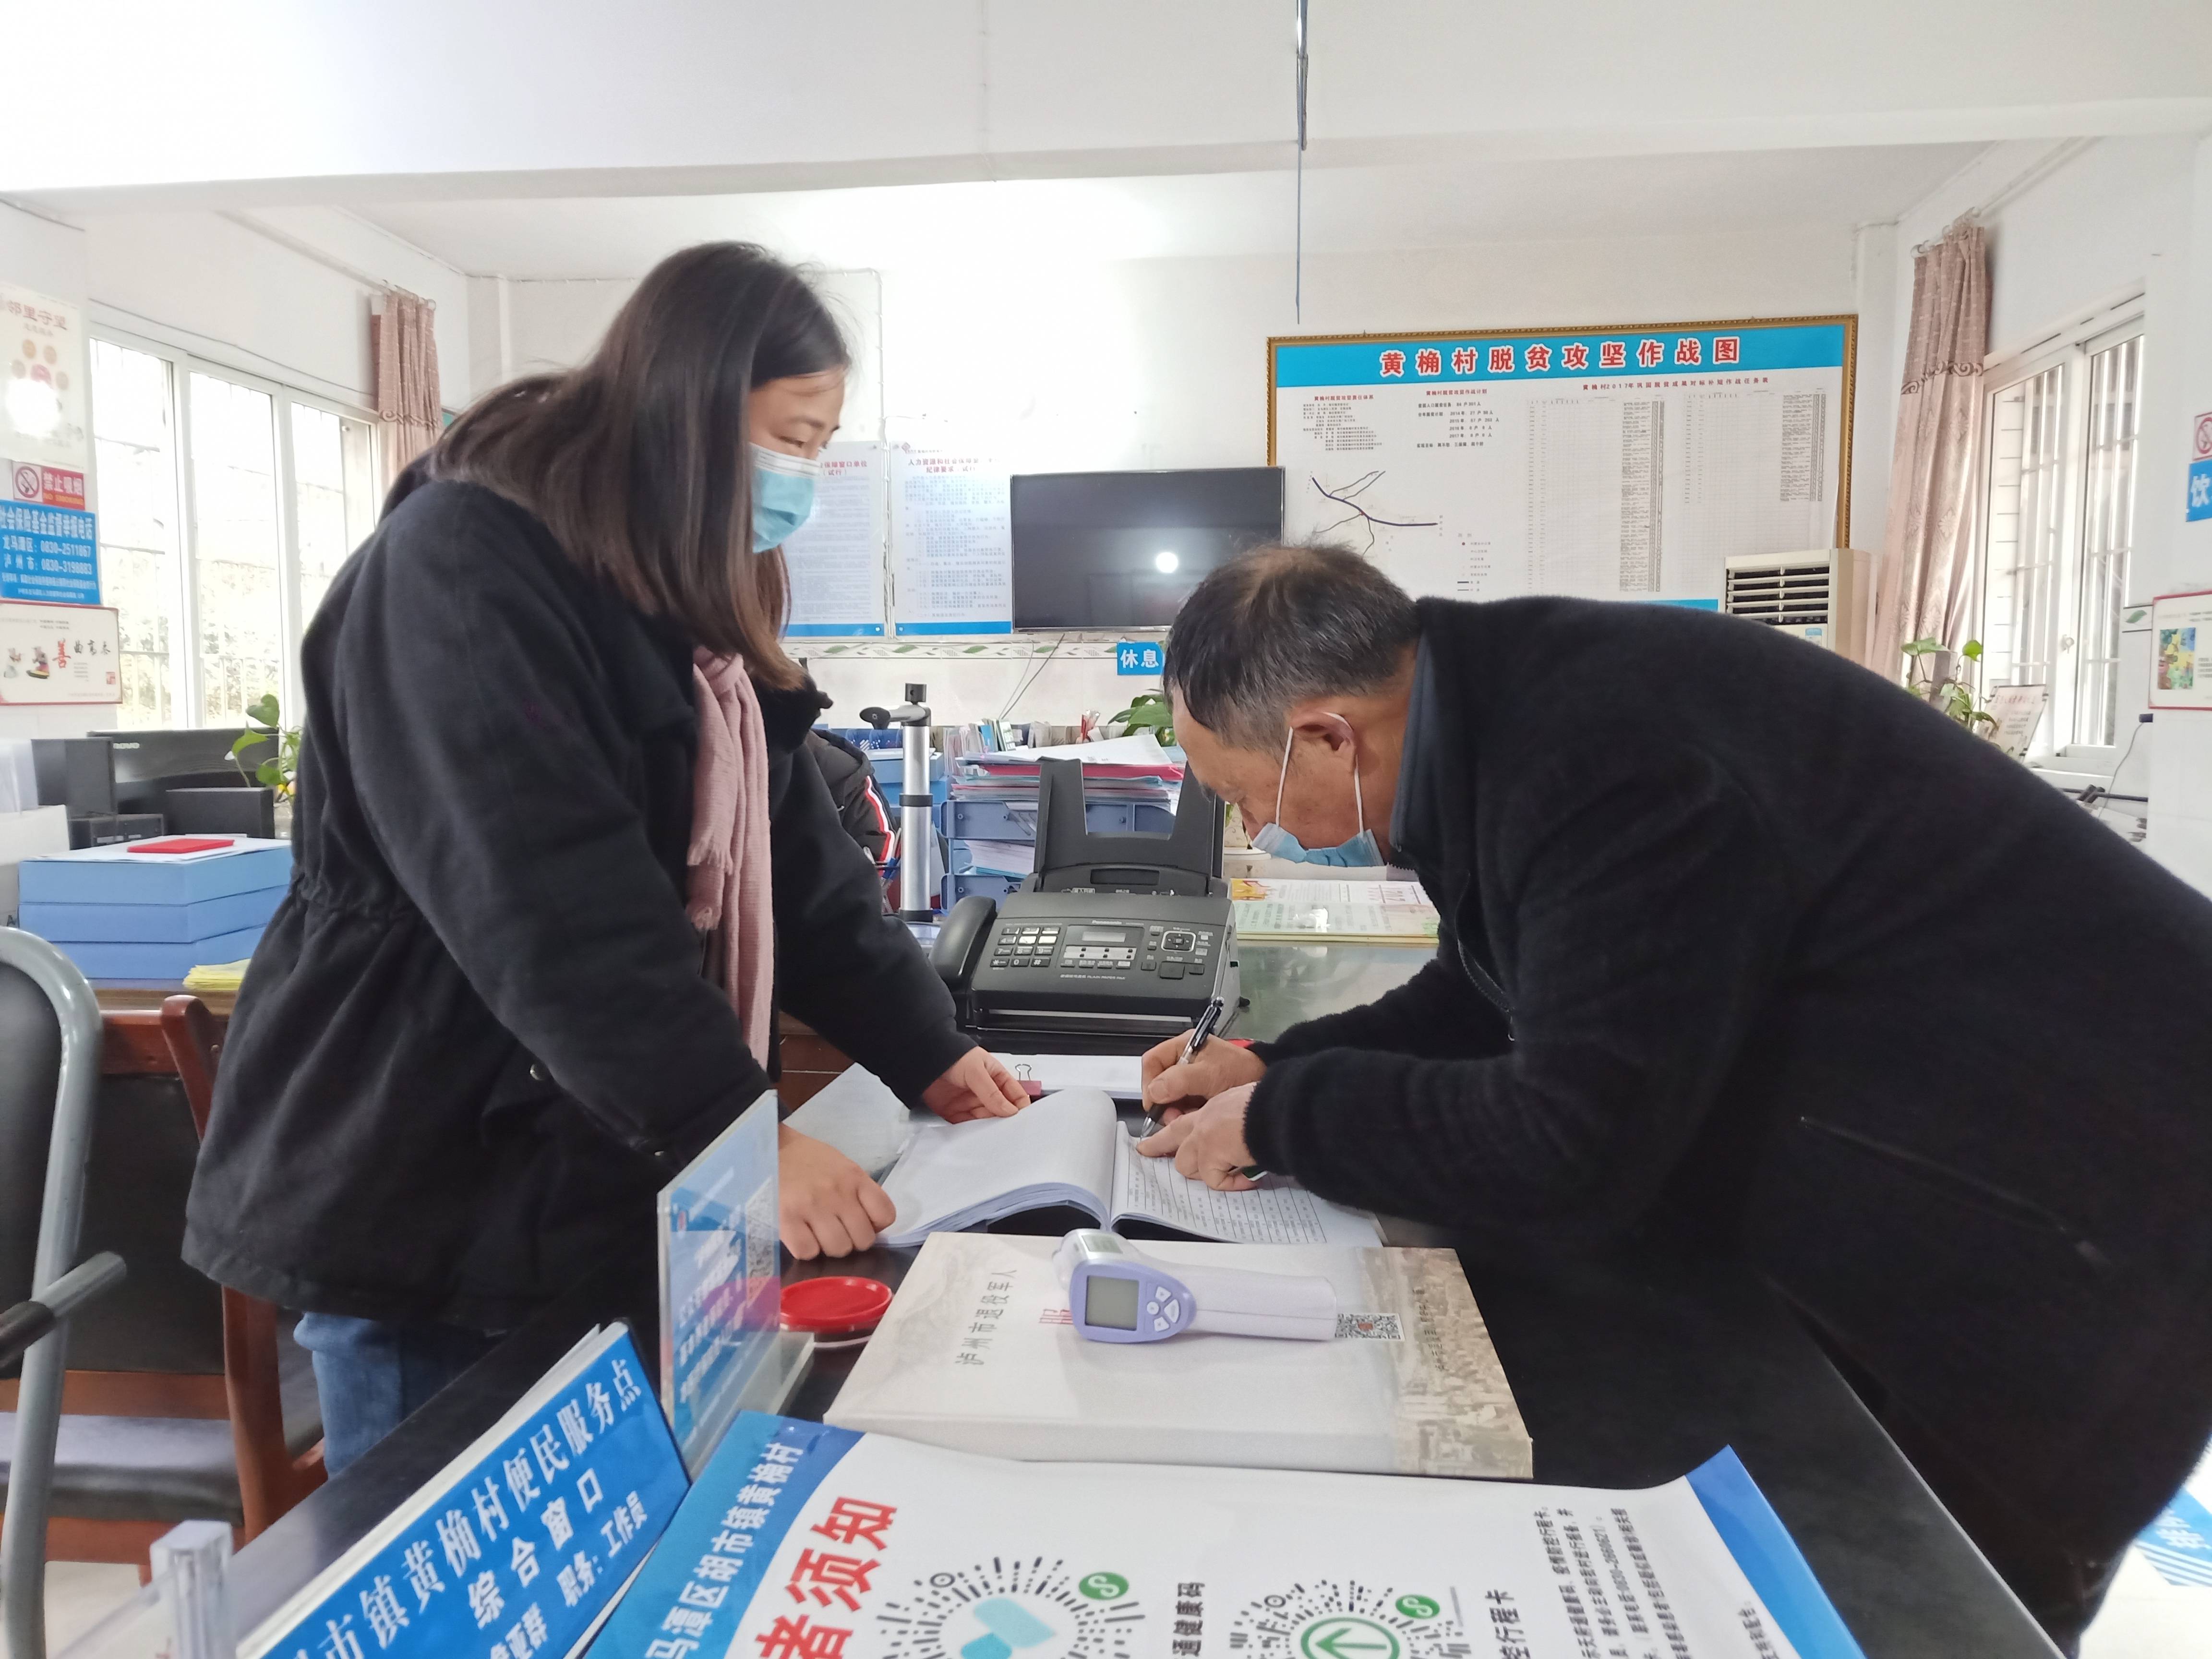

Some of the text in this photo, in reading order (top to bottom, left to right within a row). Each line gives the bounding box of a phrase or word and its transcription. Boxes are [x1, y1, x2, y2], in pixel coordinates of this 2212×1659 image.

[1381, 337, 1739, 375] 黄桷村脱贫攻坚作战图
[1120, 649, 1159, 668] 休息
[955, 1270, 1017, 1365] 泸州市退役军人
[292, 1358, 642, 1659] 市镇黄桷村便民服务点
[468, 1467, 603, 1629] 综合窗口
[755, 1496, 897, 1659] 者须知
